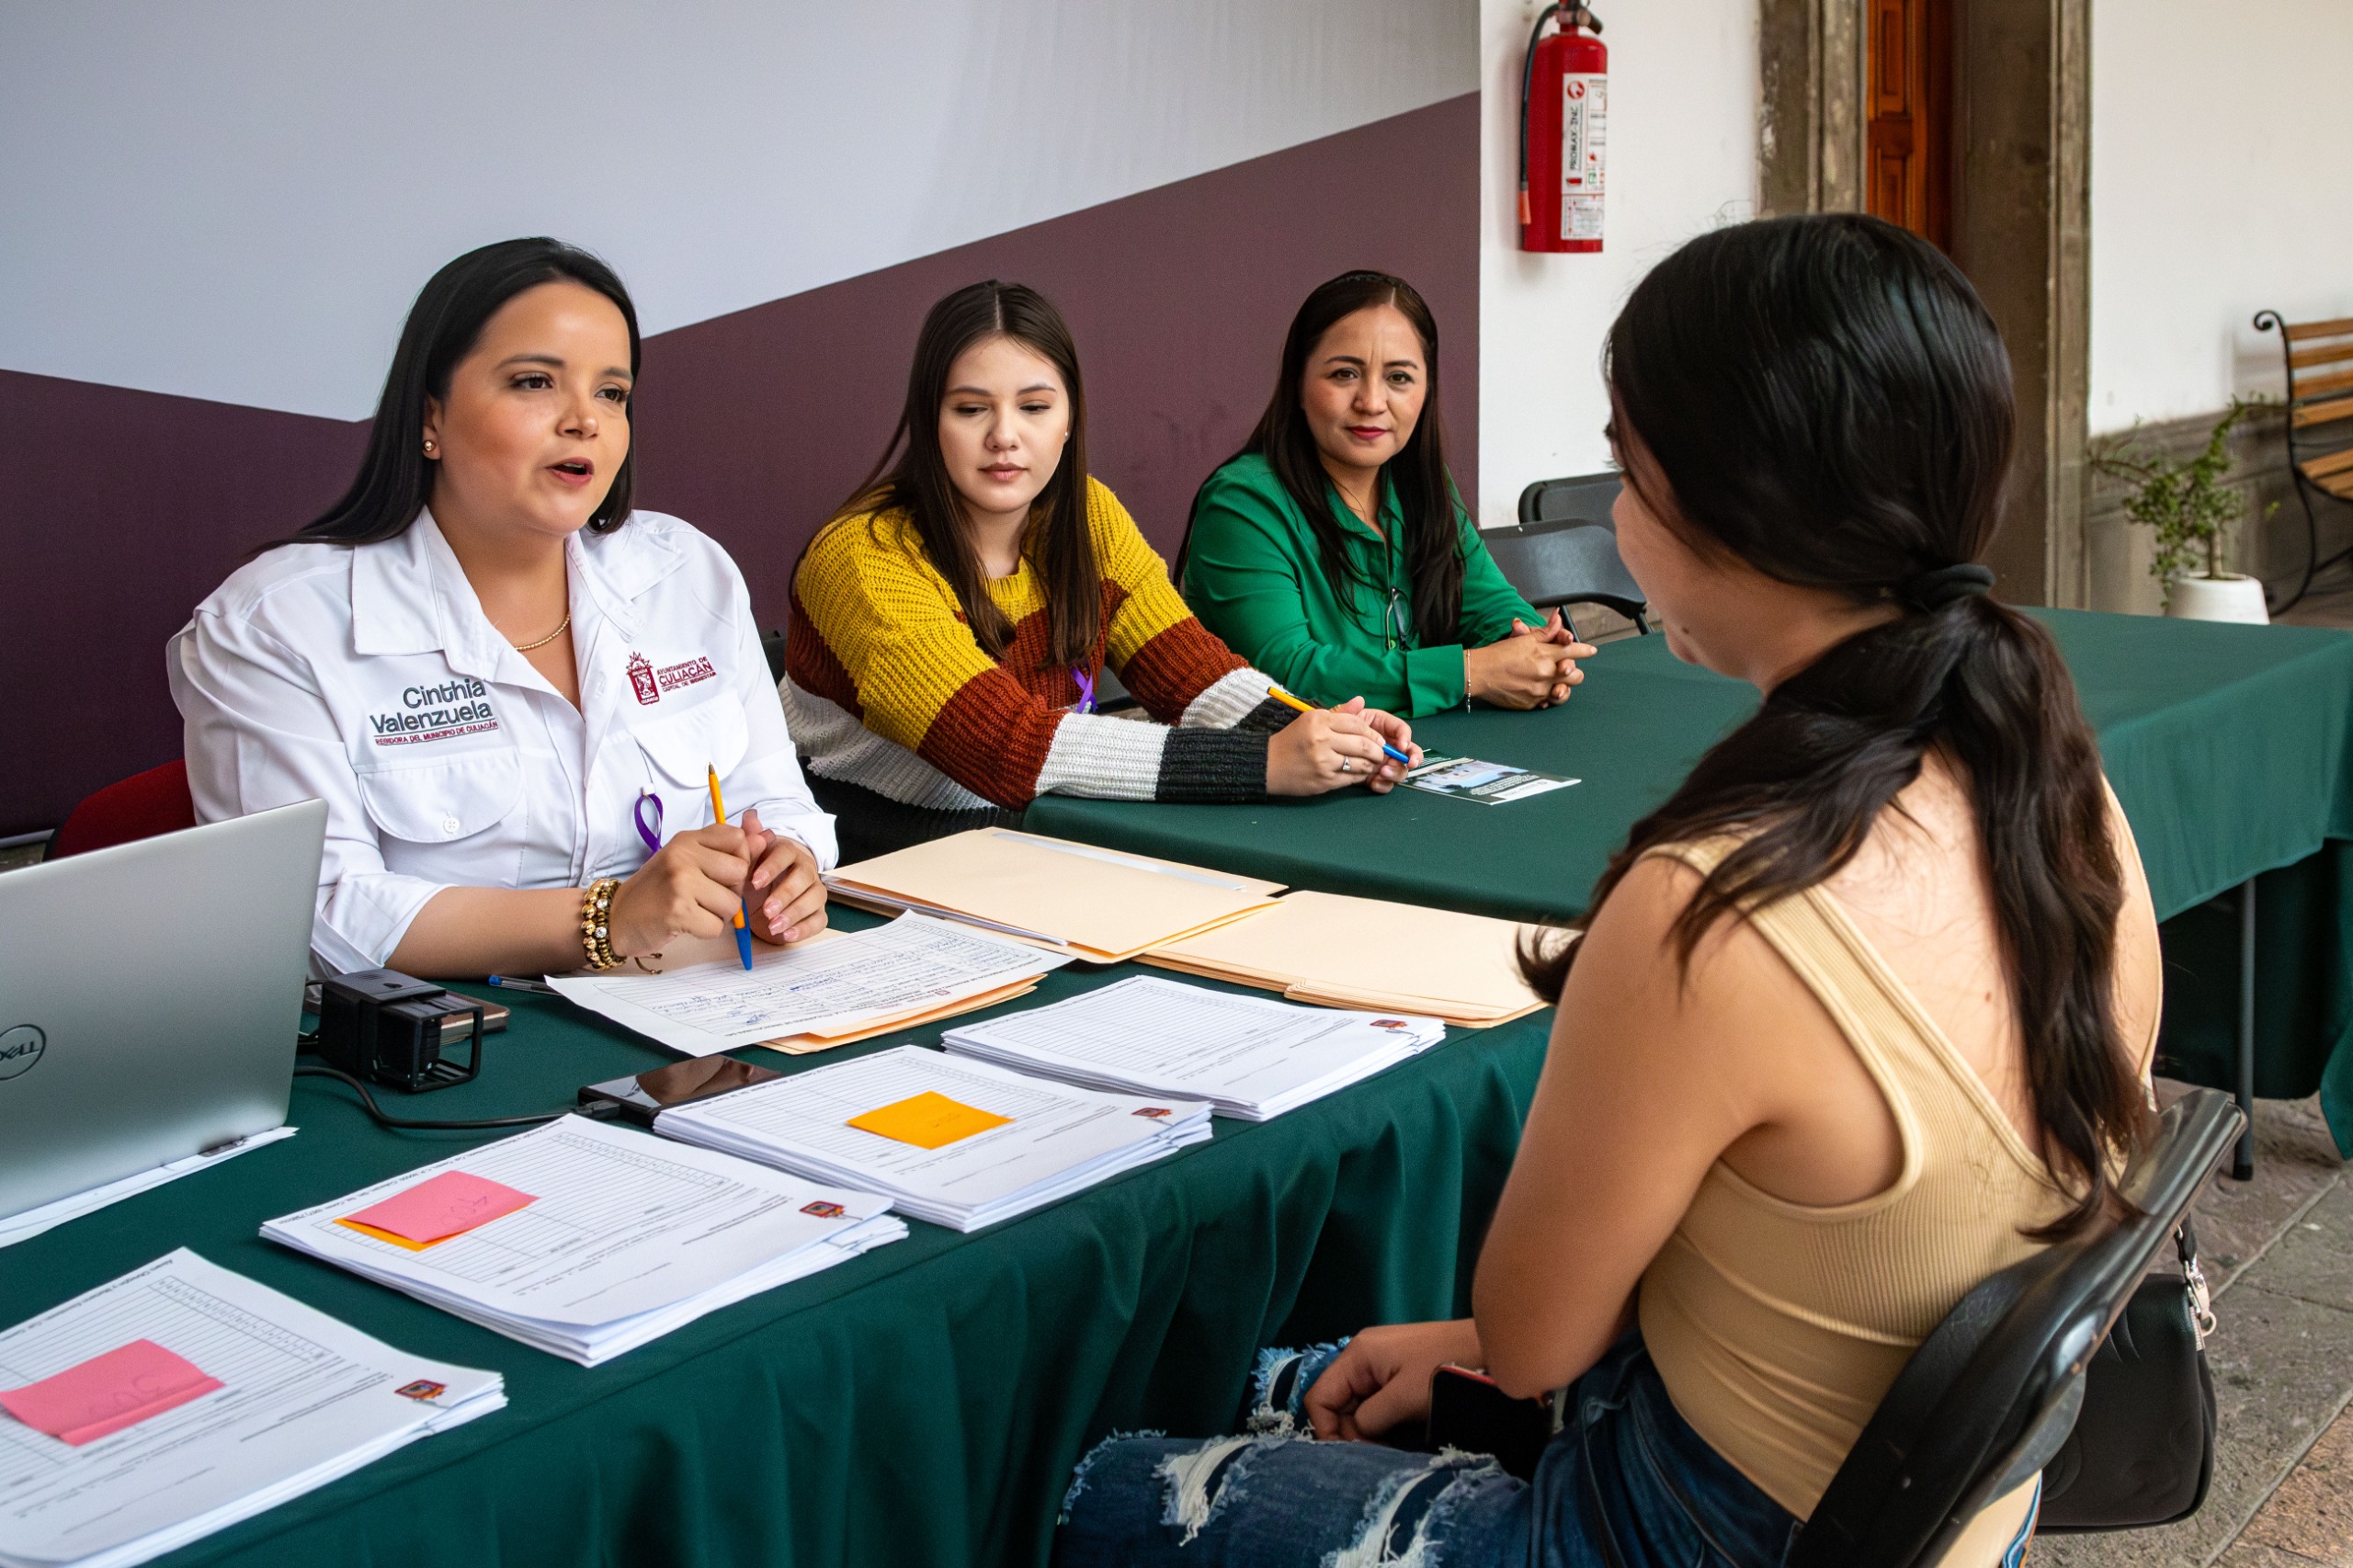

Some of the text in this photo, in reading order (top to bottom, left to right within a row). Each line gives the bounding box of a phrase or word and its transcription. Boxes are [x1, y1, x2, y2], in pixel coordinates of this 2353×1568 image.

[657, 660, 697, 676] AYUNTAMIENTO
[403, 678, 486, 709] Cinthia
[369, 700, 494, 733] Valenzuela
[375, 736, 408, 744] REGIDORA
[410, 734, 421, 744] DEL
[423, 728, 456, 741] MUNICIPIO
[456, 726, 465, 734] DE
